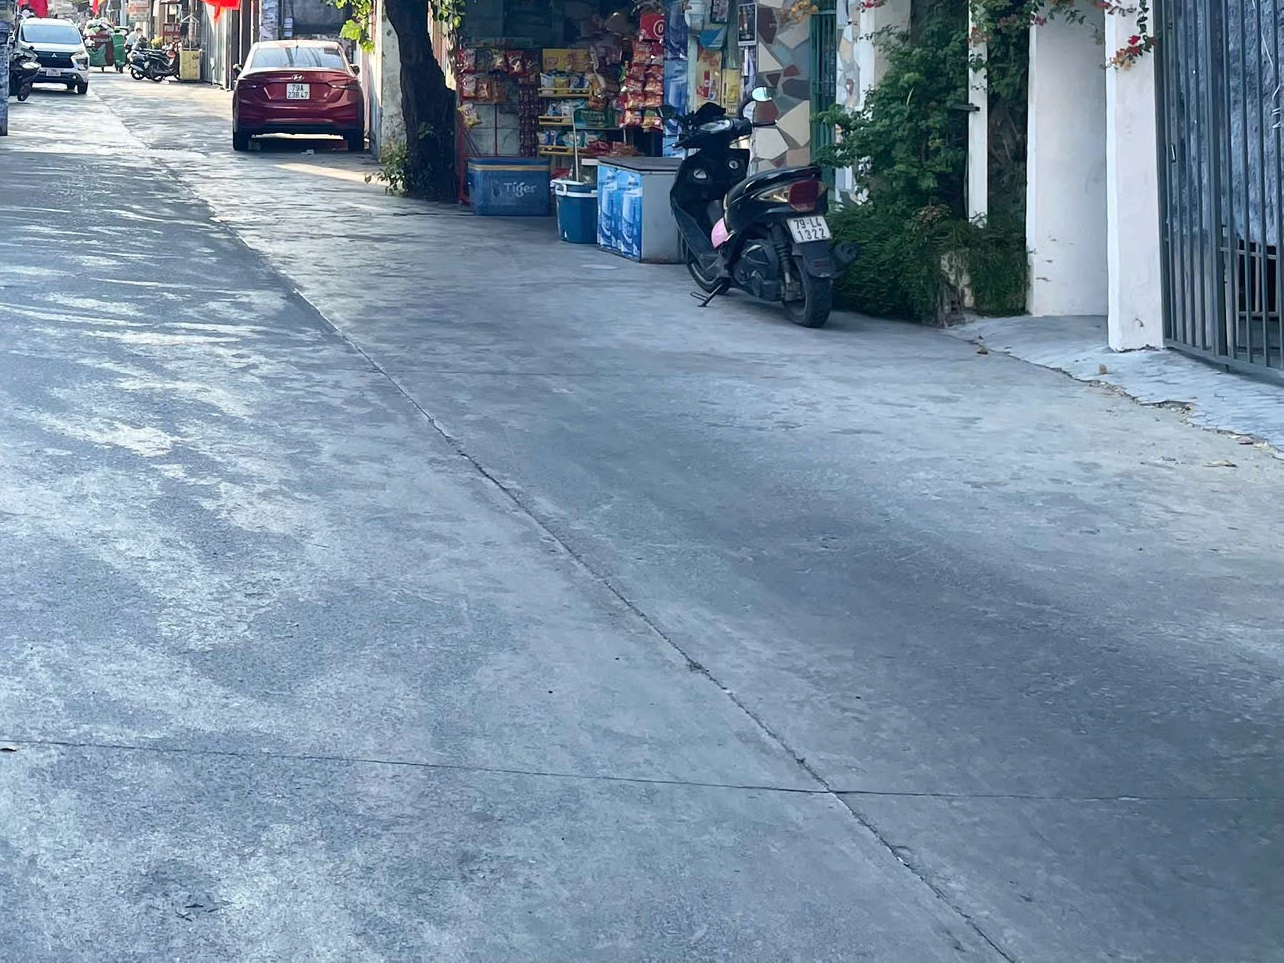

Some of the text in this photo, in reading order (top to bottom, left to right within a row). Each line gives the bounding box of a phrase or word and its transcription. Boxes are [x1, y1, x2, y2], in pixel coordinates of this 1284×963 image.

[503, 181, 537, 198] Tiger
[793, 217, 822, 230] 79-L4
[798, 228, 826, 241] 1322
